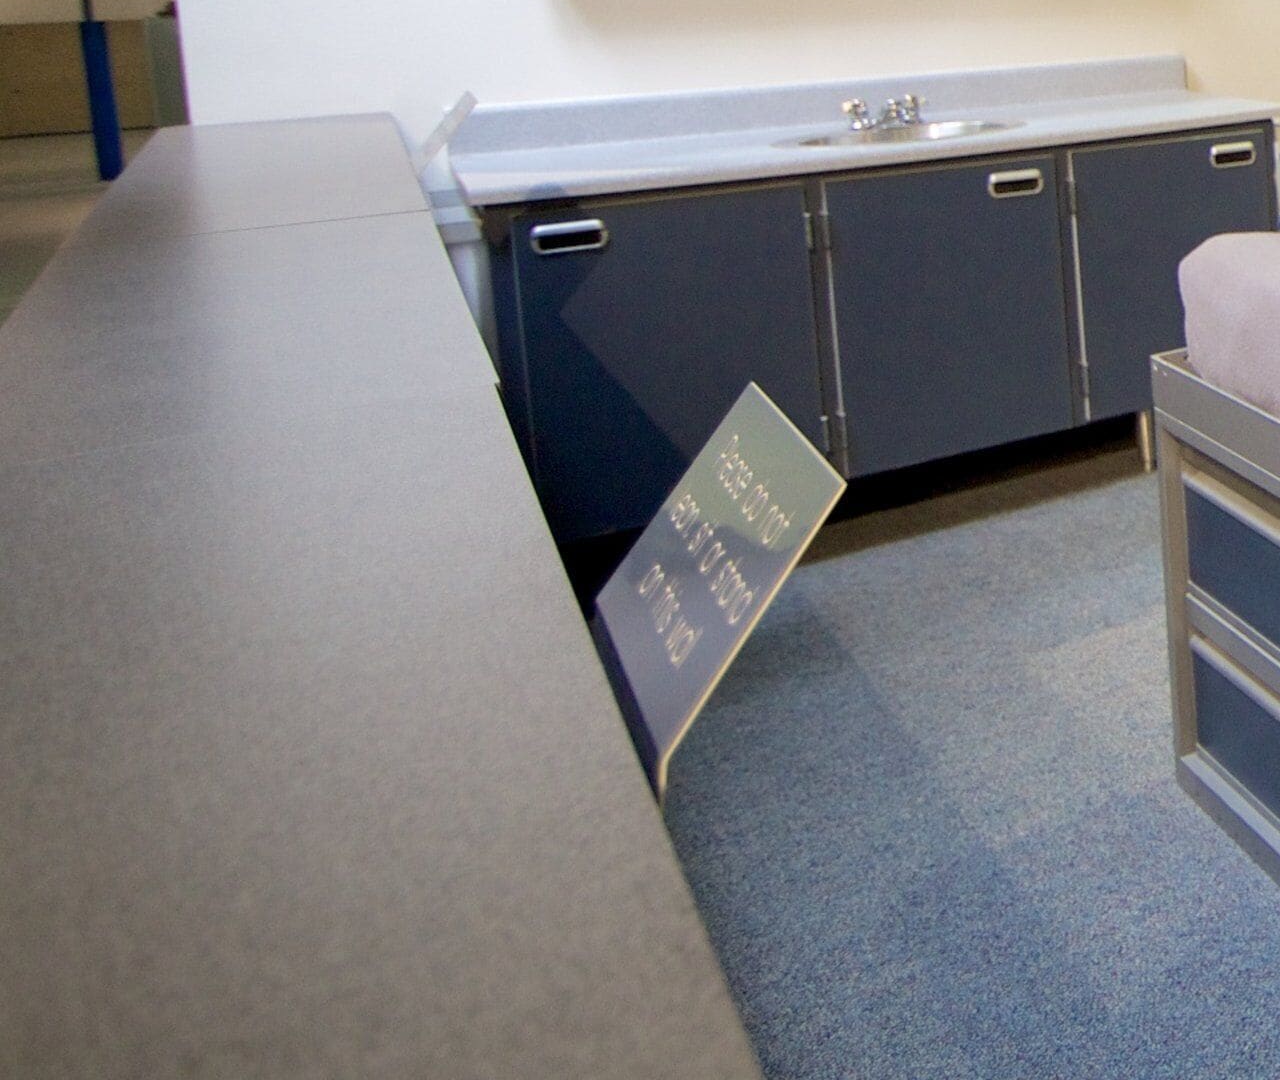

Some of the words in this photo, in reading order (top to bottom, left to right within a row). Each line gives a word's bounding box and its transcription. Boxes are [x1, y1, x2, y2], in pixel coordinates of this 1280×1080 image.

[754, 498, 795, 552] not
[636, 558, 667, 602] on
[696, 537, 728, 579] or
